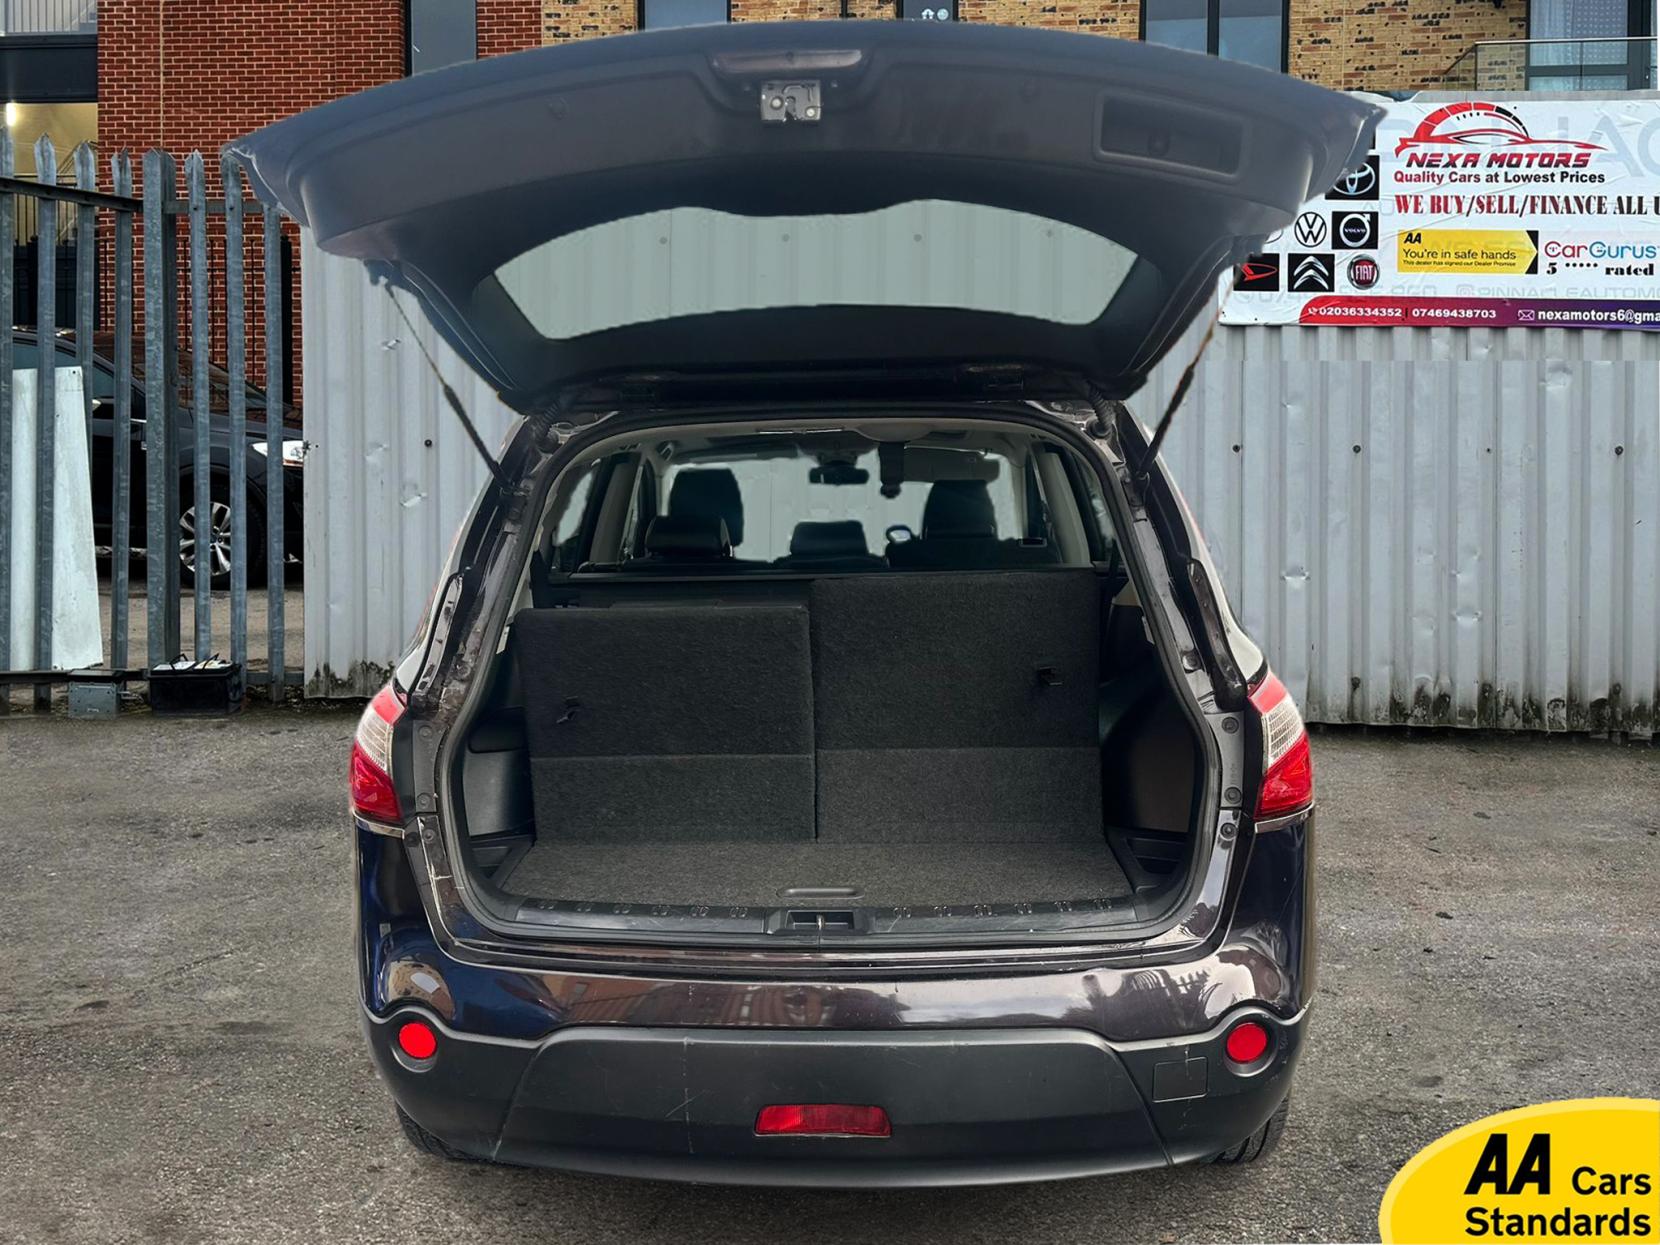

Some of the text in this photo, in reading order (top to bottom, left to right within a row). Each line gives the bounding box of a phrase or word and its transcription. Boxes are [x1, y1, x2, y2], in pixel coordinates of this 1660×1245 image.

[1406, 152, 1592, 168] NEXA MOTORS
[1394, 170, 1605, 185] Quality Cars at Lowest Prices
[1395, 195, 1424, 214] WE
[1613, 195, 1648, 215] ALL
[1404, 232, 1422, 244] AA
[1403, 248, 1517, 260] You're in safe hands
[1544, 240, 1657, 259] CarGurus
[1355, 265, 1374, 280] FIAT
[1546, 262, 1654, 276] 5 rated
[1319, 307, 1497, 319] 02036334352 07469438703
